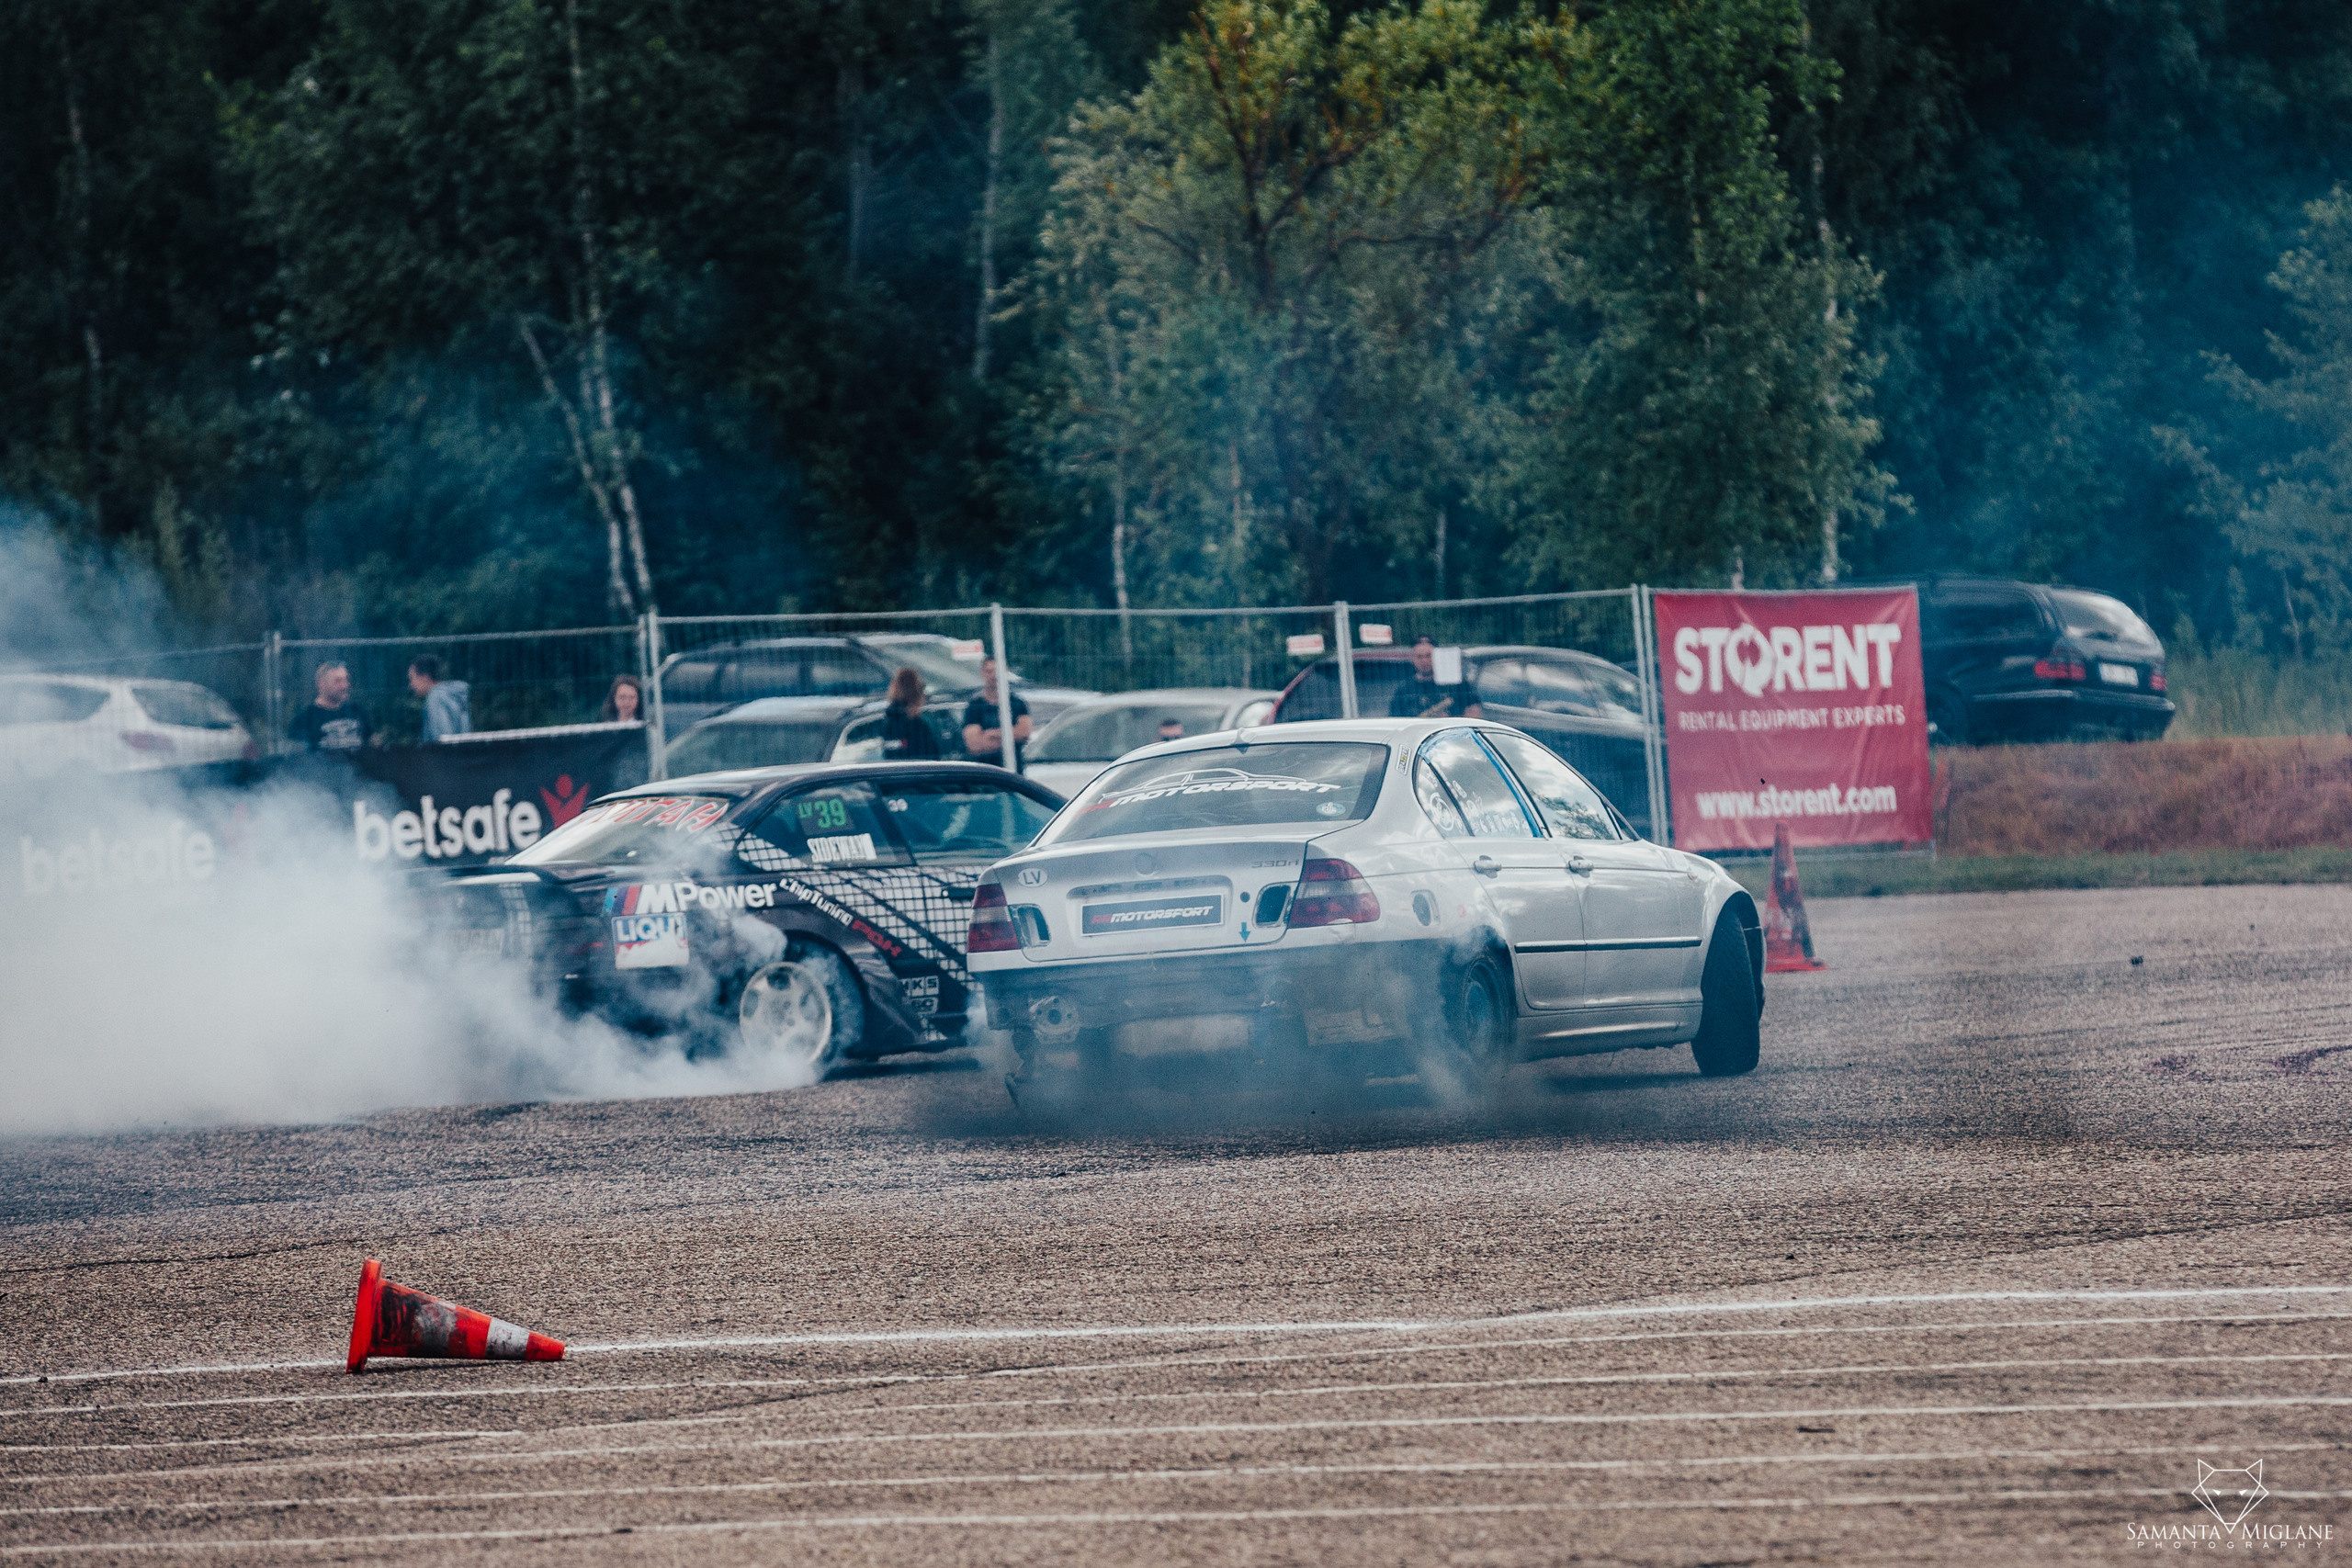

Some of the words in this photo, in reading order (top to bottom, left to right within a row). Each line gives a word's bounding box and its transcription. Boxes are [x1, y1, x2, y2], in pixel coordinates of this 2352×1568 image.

[1673, 623, 1902, 698] STORENT
[1679, 711, 1737, 732] RENTAL
[1739, 707, 1828, 732] EQUIPMENT
[1832, 704, 1906, 729] EXPERTS
[814, 798, 846, 829] 39
[1695, 783, 1898, 819] www.storent.com
[354, 787, 543, 861] betsafe
[1023, 871, 1041, 885] LV
